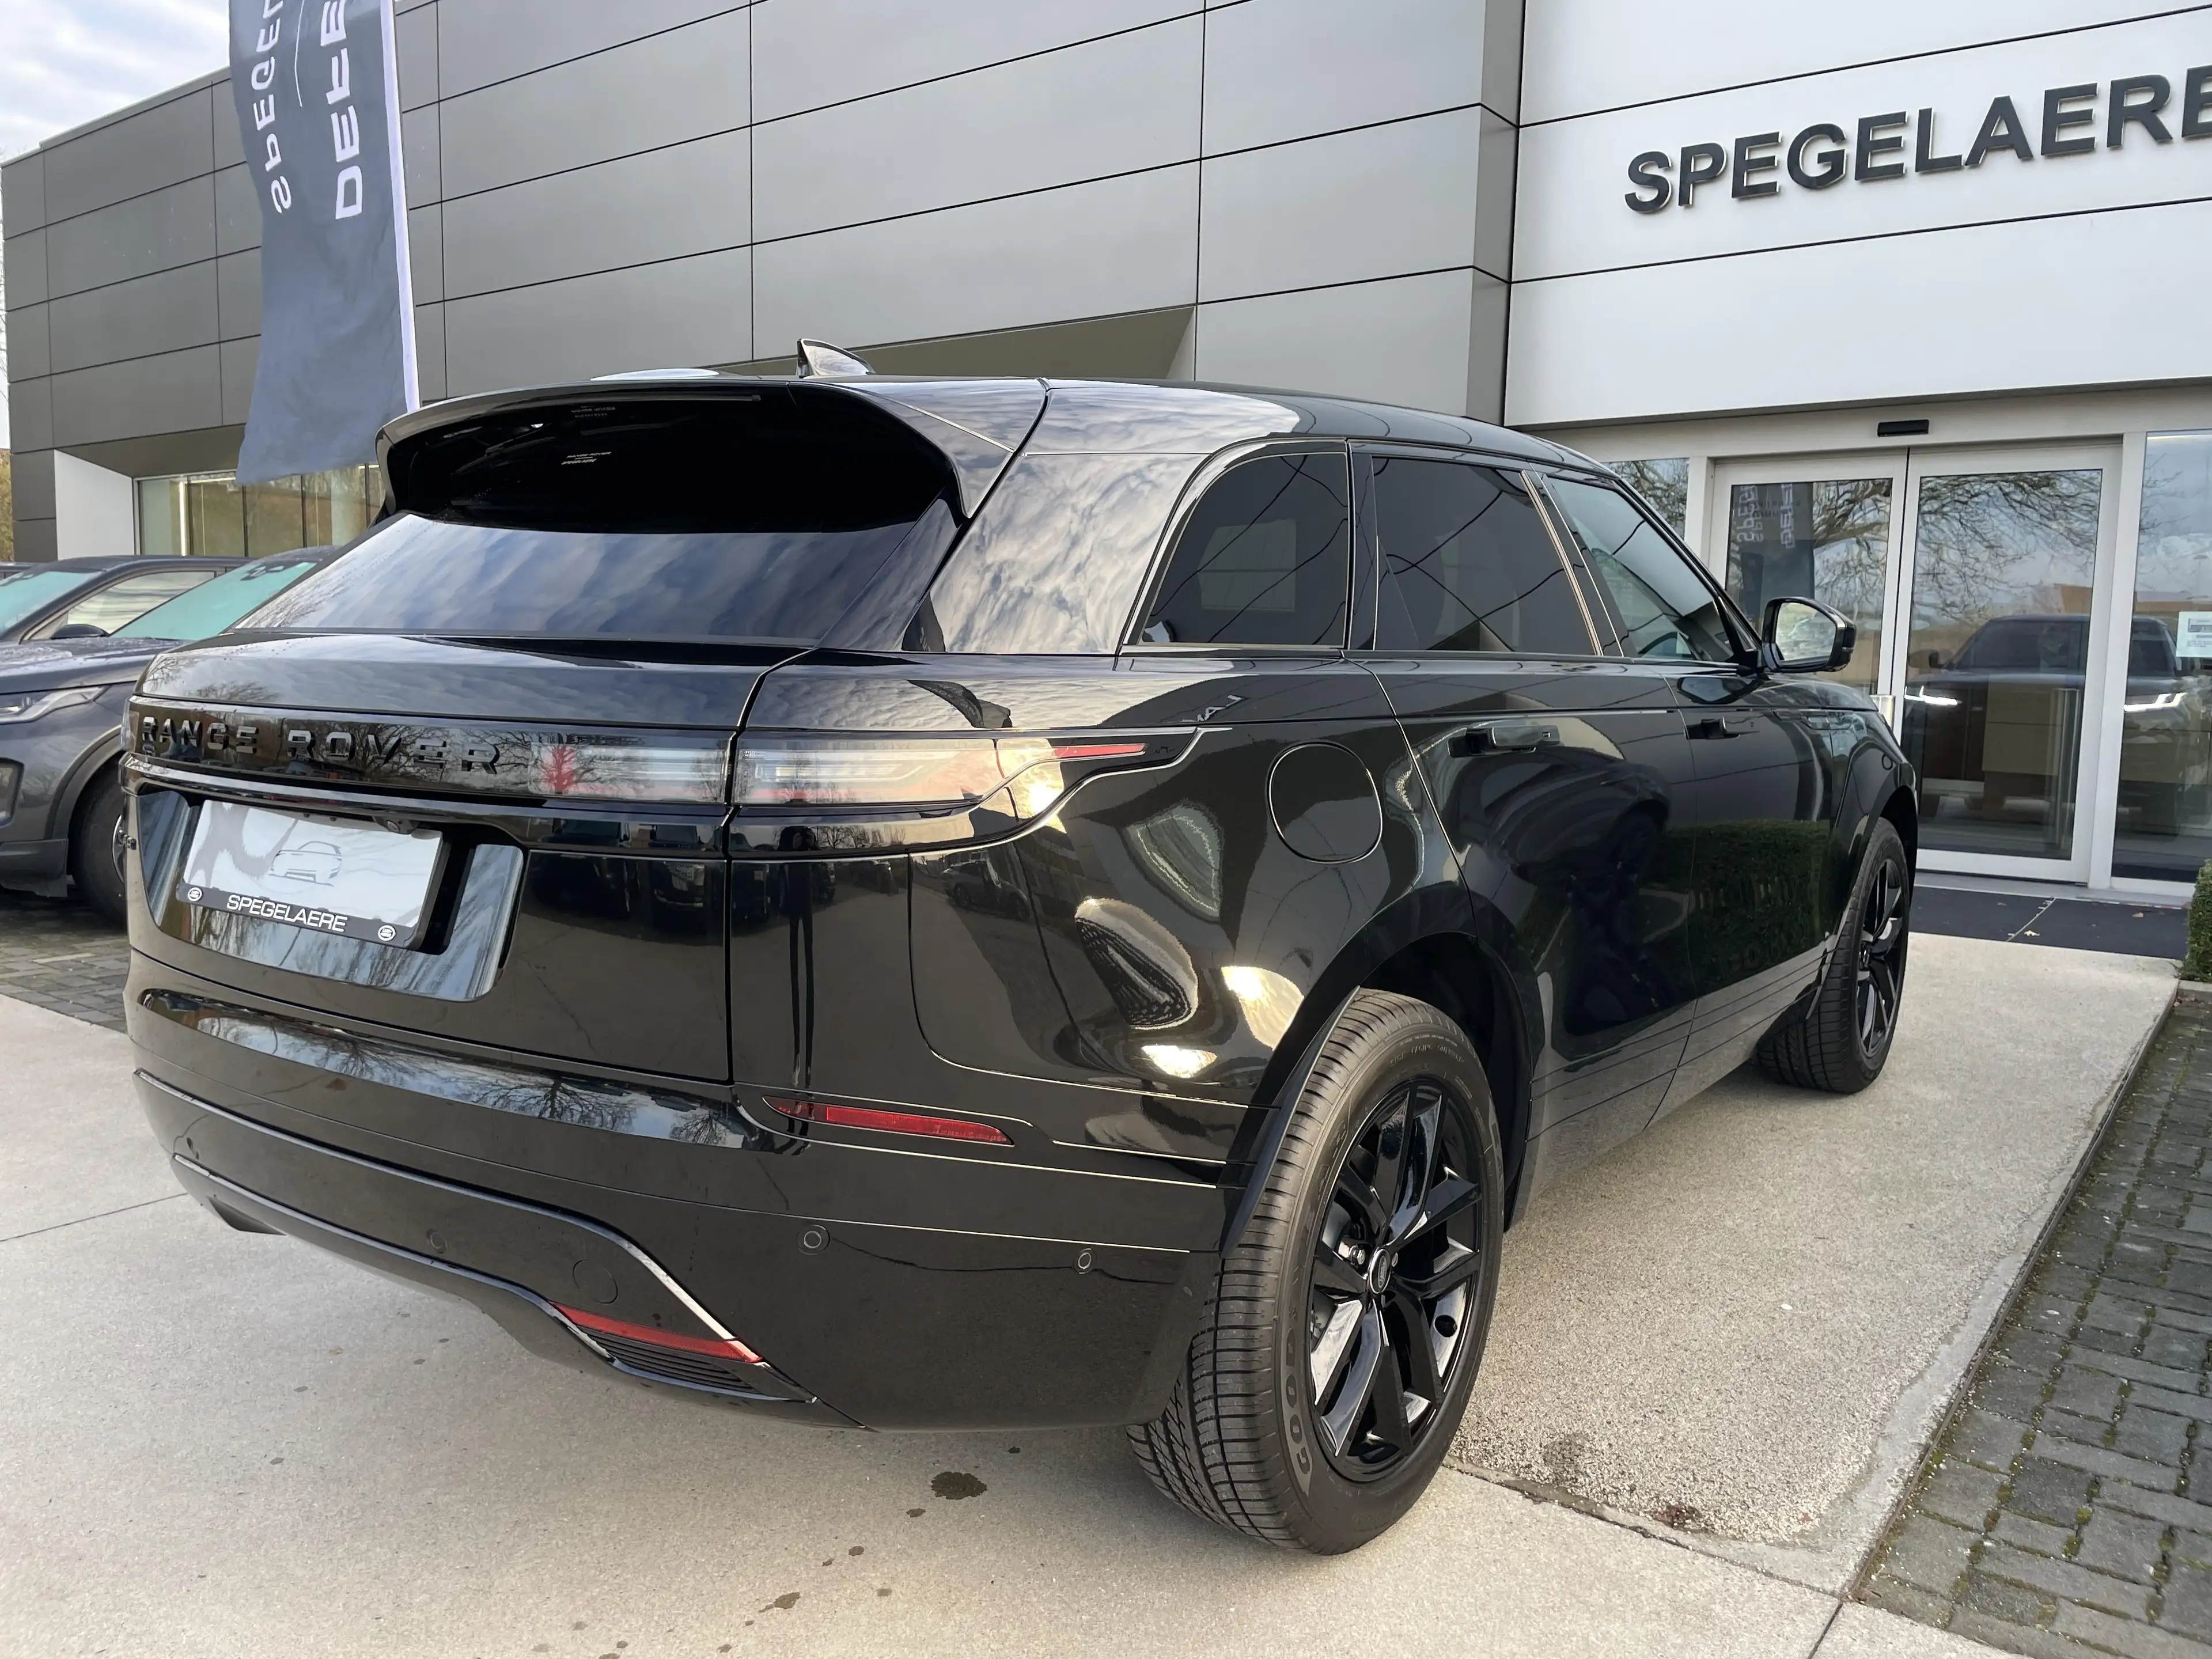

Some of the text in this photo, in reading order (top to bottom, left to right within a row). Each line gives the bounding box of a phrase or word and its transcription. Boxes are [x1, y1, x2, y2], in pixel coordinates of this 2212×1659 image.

[142, 716, 500, 775] RANGE ROVER
[226, 894, 348, 933] SPEGELAERE
